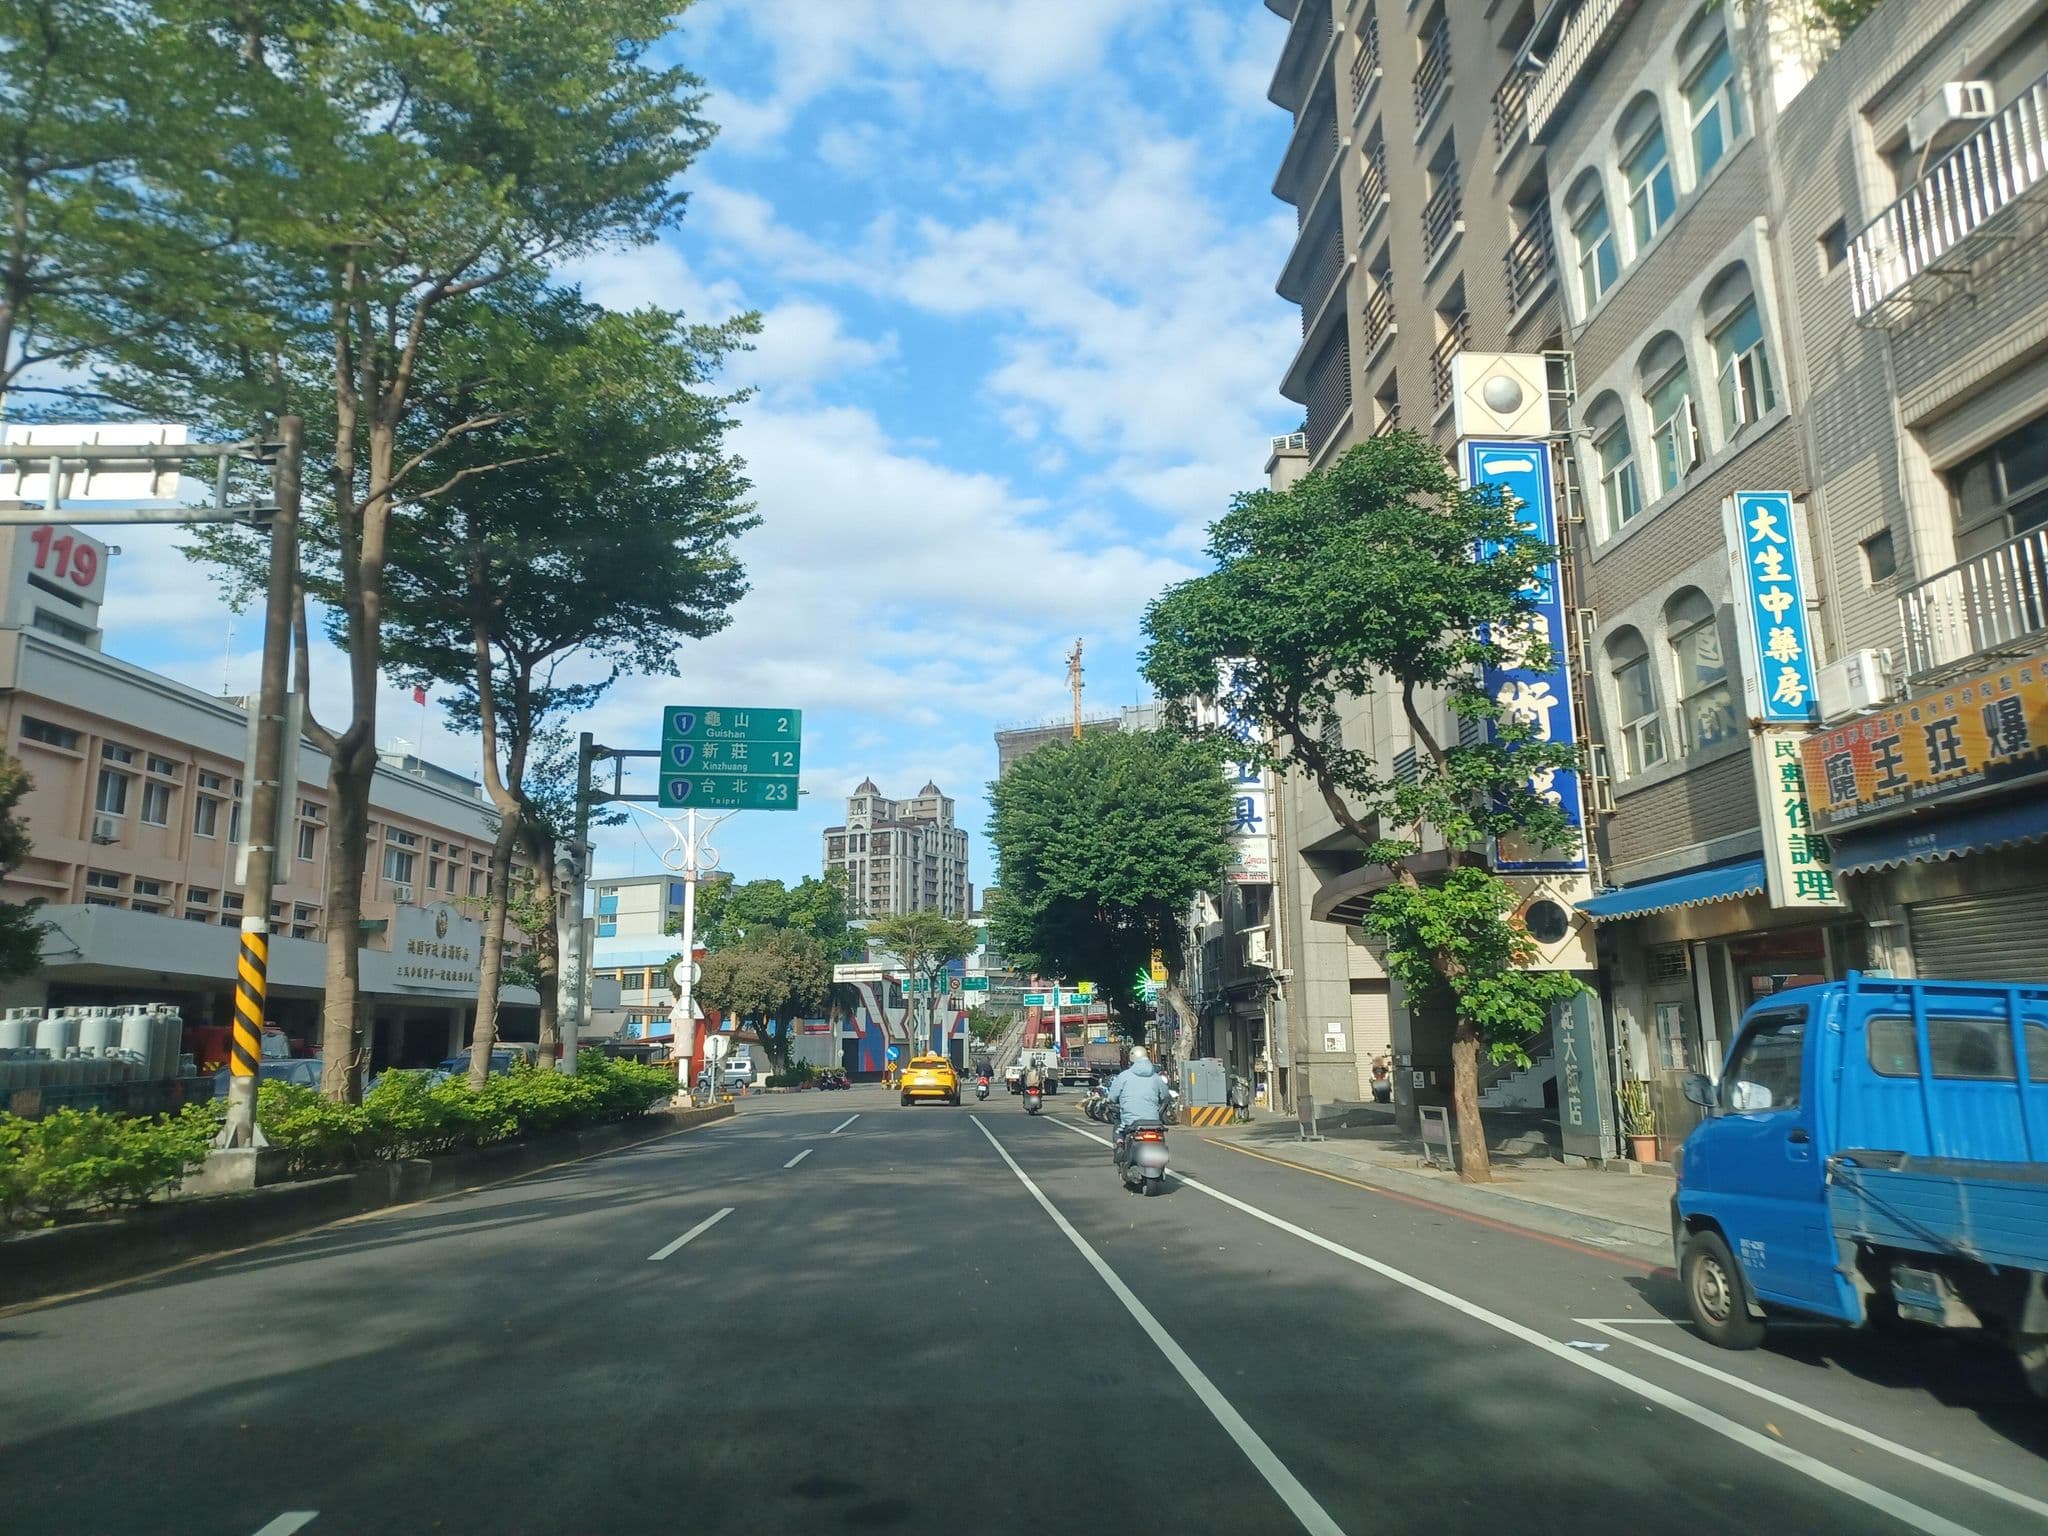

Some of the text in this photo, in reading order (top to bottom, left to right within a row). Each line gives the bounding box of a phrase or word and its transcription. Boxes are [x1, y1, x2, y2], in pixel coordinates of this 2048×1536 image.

[31, 524, 97, 587] 119
[1749, 506, 1808, 707] 大生中藥房
[681, 716, 687, 729] 1
[704, 710, 749, 728] 龜山
[777, 717, 788, 732] 2
[706, 728, 746, 739] Guishan
[679, 748, 685, 761] 1
[702, 742, 748, 760] 新莊
[702, 760, 748, 772] Xinzhuang
[772, 751, 794, 767] 12
[677, 783, 682, 796] 1
[701, 777, 748, 793] 台北
[765, 783, 788, 801] 23
[710, 797, 741, 805] Taipei
